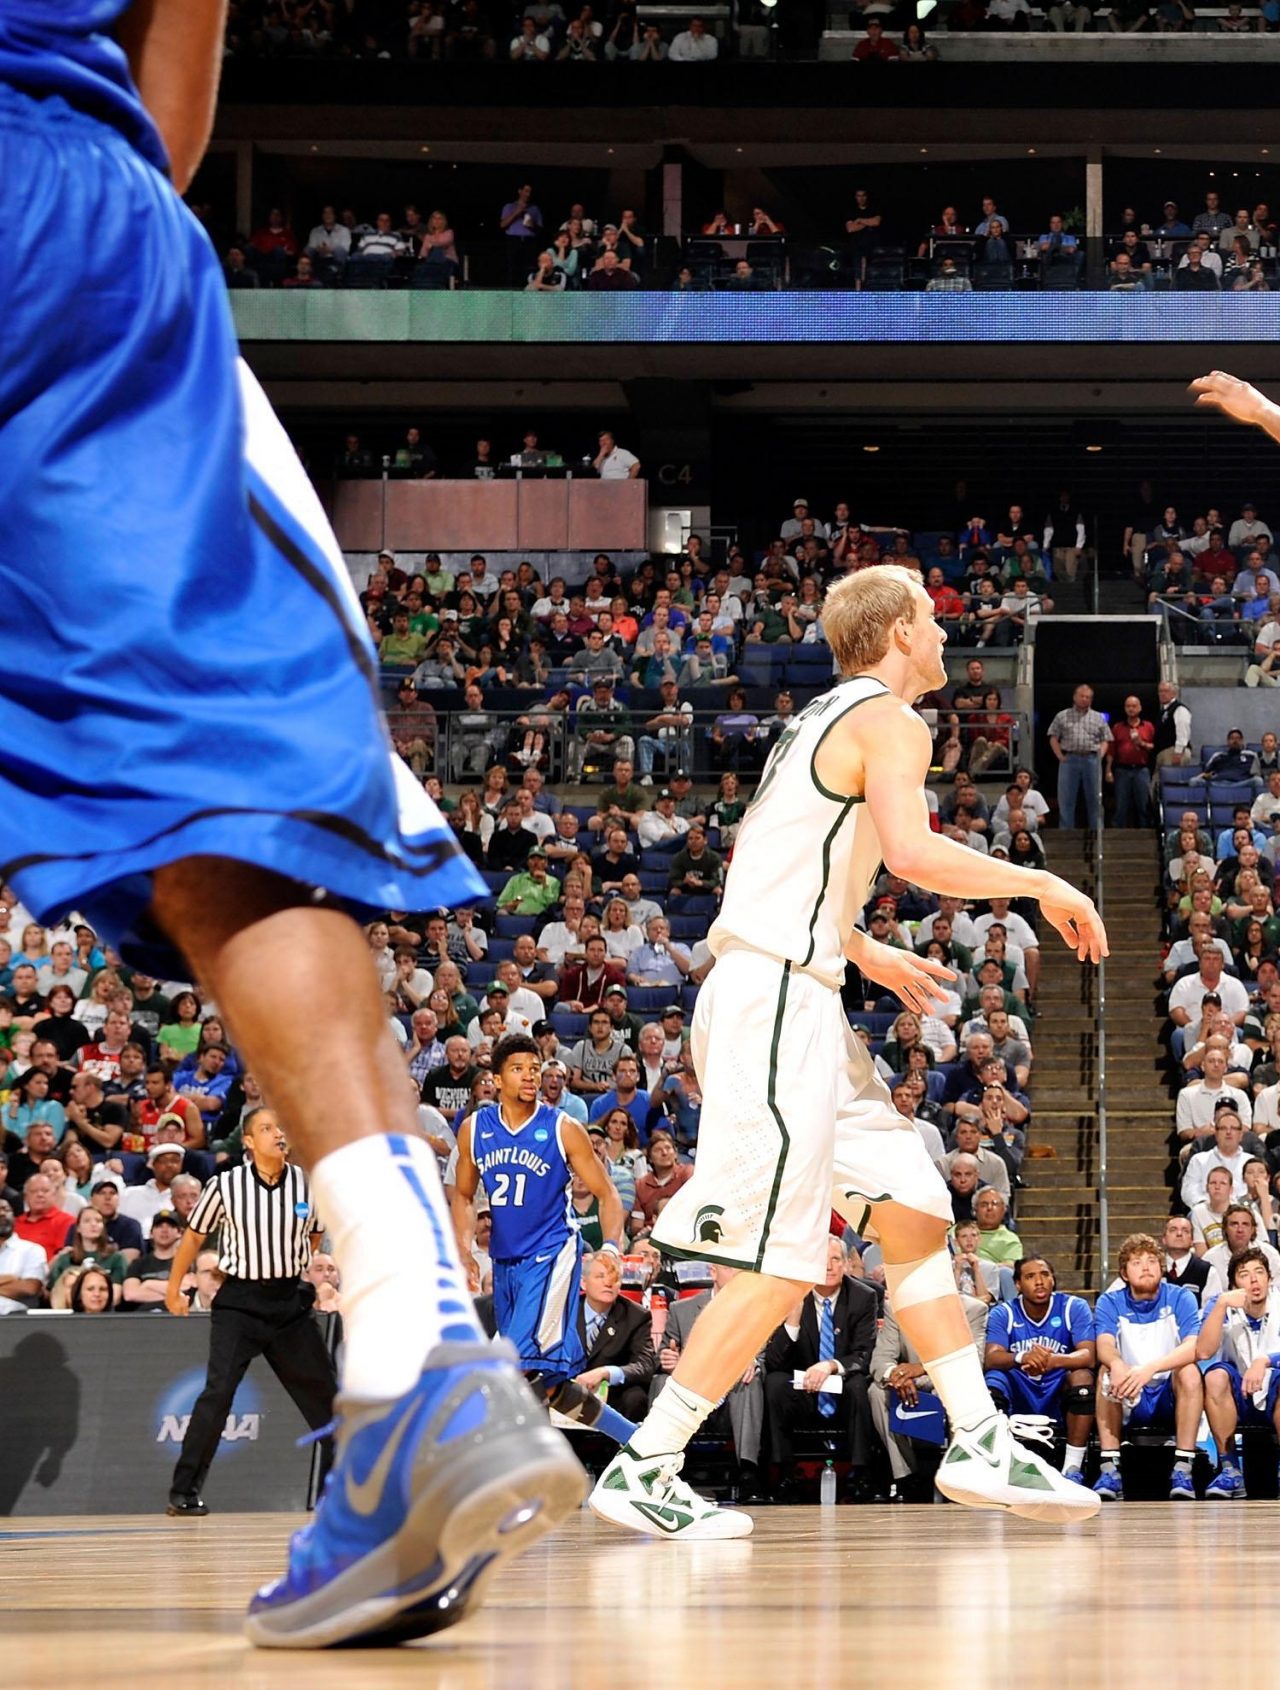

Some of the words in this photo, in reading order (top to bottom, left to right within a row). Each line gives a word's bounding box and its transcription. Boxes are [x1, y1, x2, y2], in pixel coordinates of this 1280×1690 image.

[658, 464, 693, 485] C4
[491, 1173, 527, 1206] 21
[156, 1413, 262, 1442] NAA
